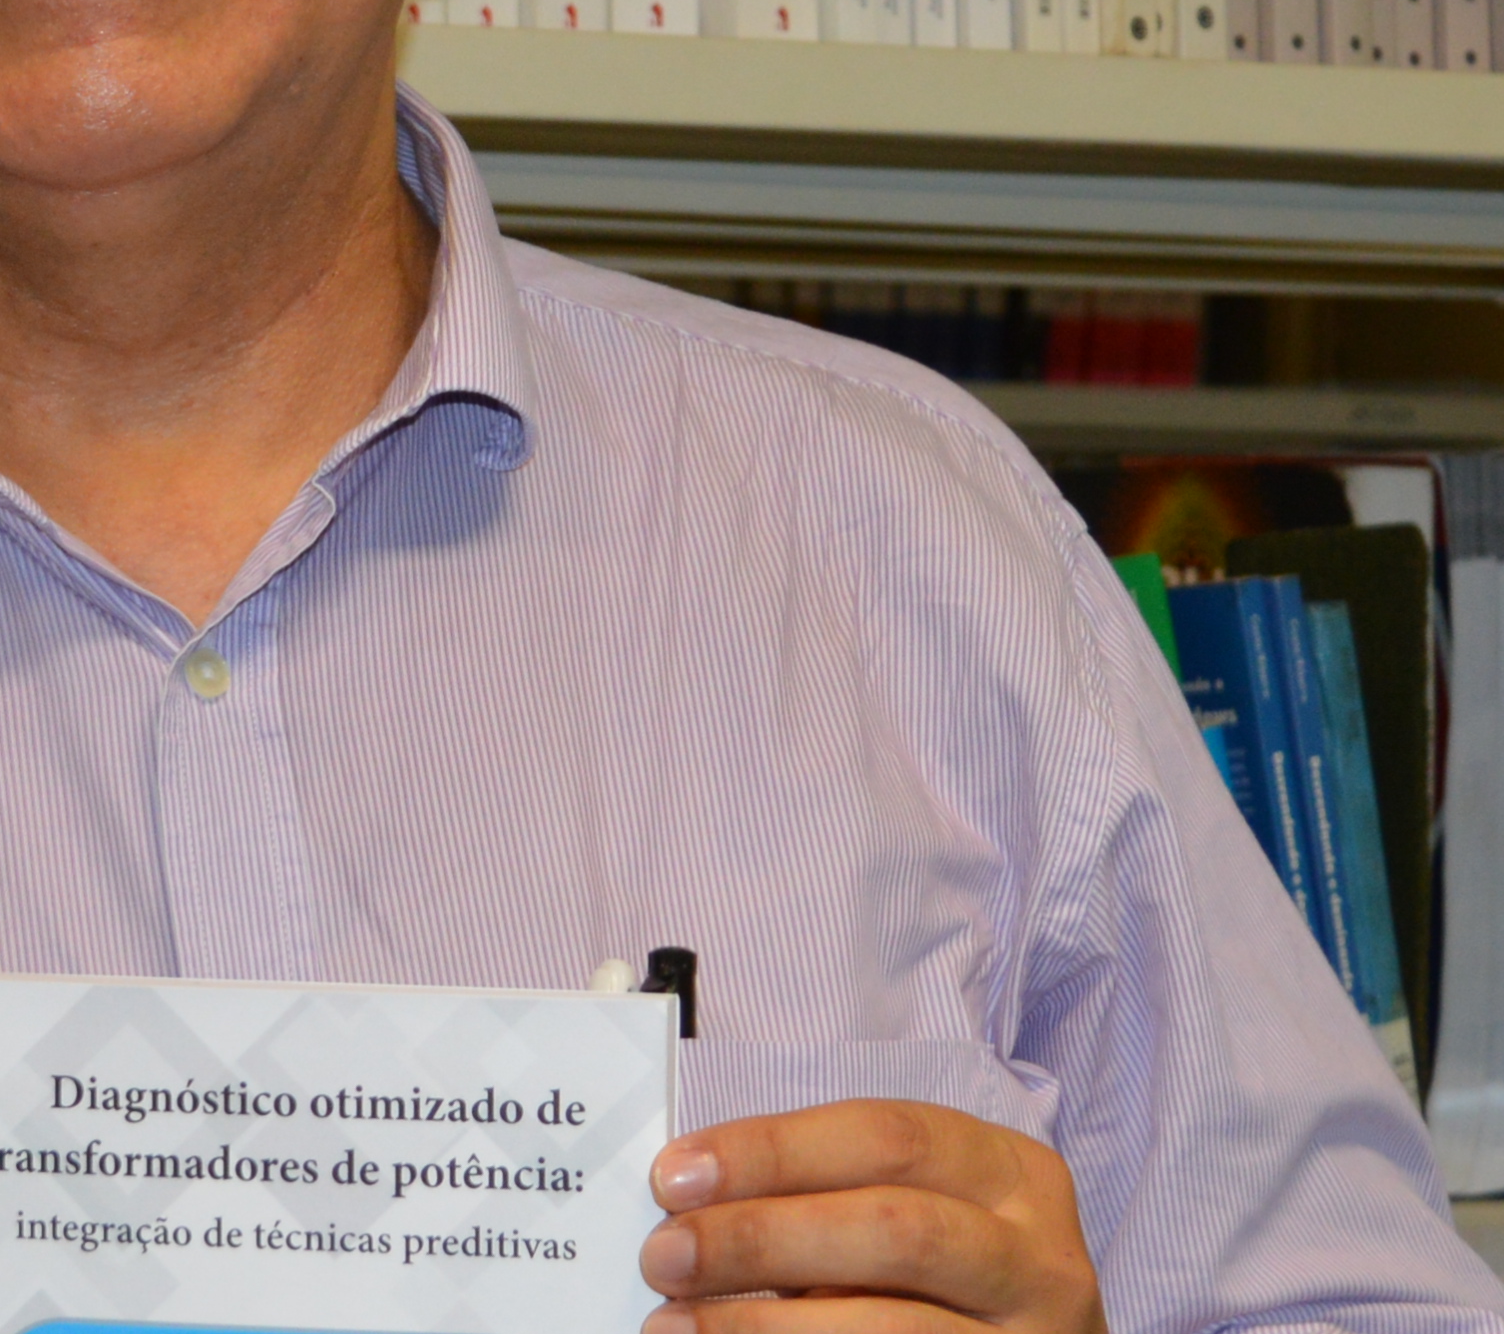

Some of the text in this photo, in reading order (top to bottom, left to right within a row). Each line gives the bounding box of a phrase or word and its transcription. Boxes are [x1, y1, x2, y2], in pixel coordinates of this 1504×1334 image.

[50, 1073, 587, 1126] Diagnóstico otimizado de
[331, 1148, 380, 1185] de
[392, 1152, 585, 1198] potência:
[15, 1209, 578, 1264] integração de técnicas preditivas
